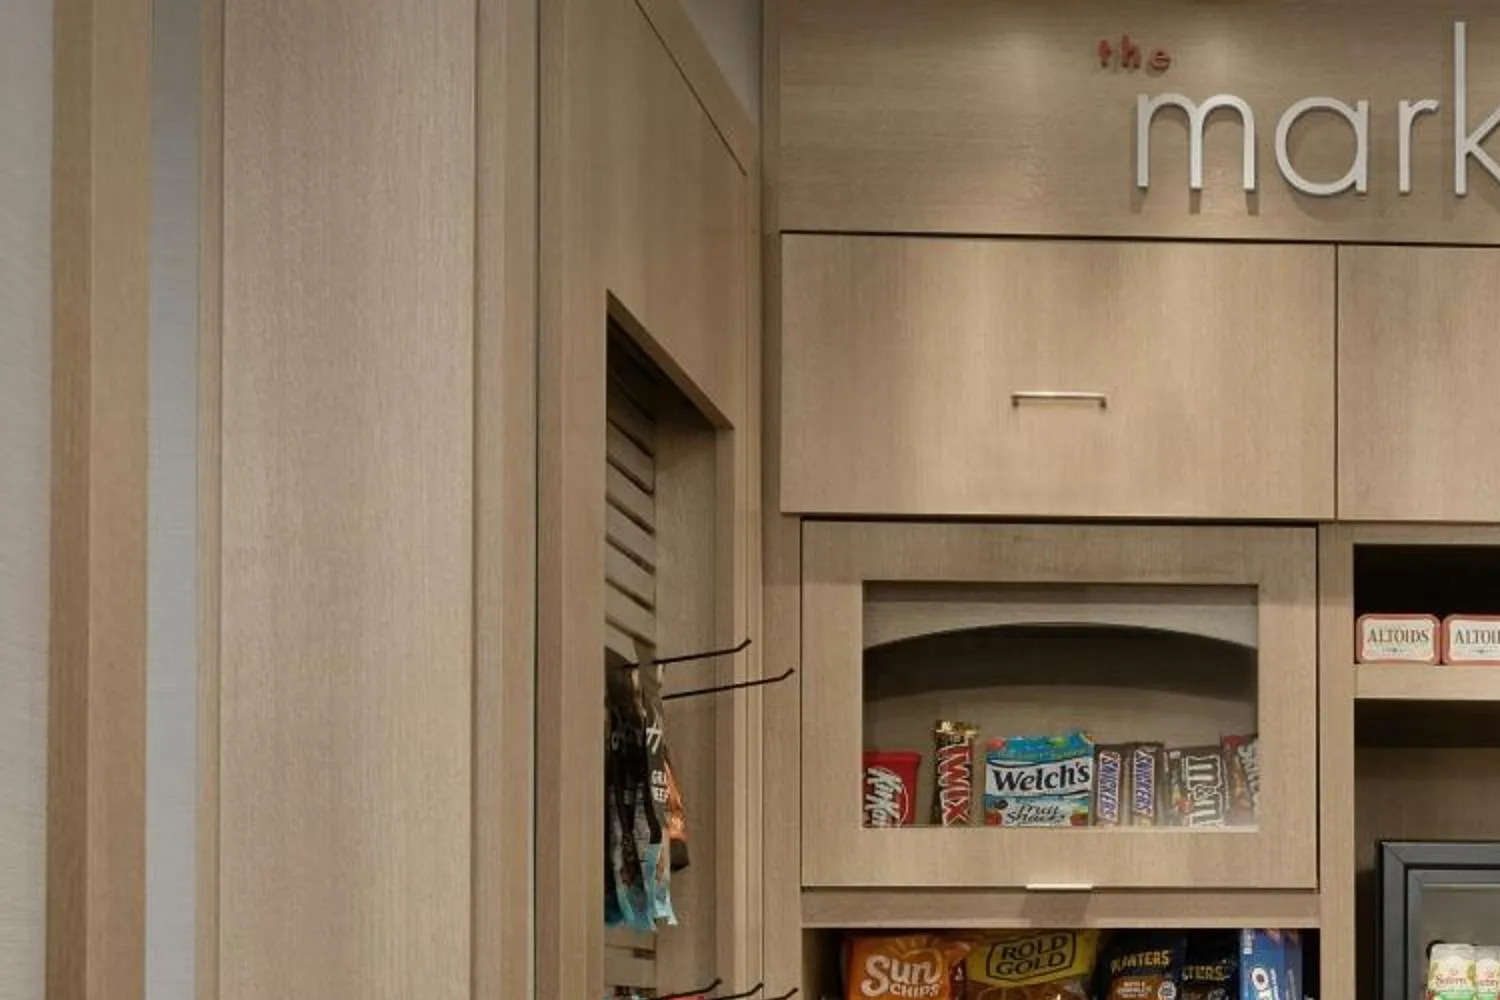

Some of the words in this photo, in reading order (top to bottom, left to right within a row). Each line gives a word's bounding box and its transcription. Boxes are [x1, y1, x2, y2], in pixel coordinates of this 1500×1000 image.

[1098, 35, 1171, 72] the
[1367, 628, 1430, 644] ALTOIDS
[937, 738, 971, 826] TWIX
[992, 760, 1091, 793] Welch's
[995, 951, 1067, 975] GOLD
[1001, 935, 1069, 960] ROLD
[861, 954, 943, 997] Sun
